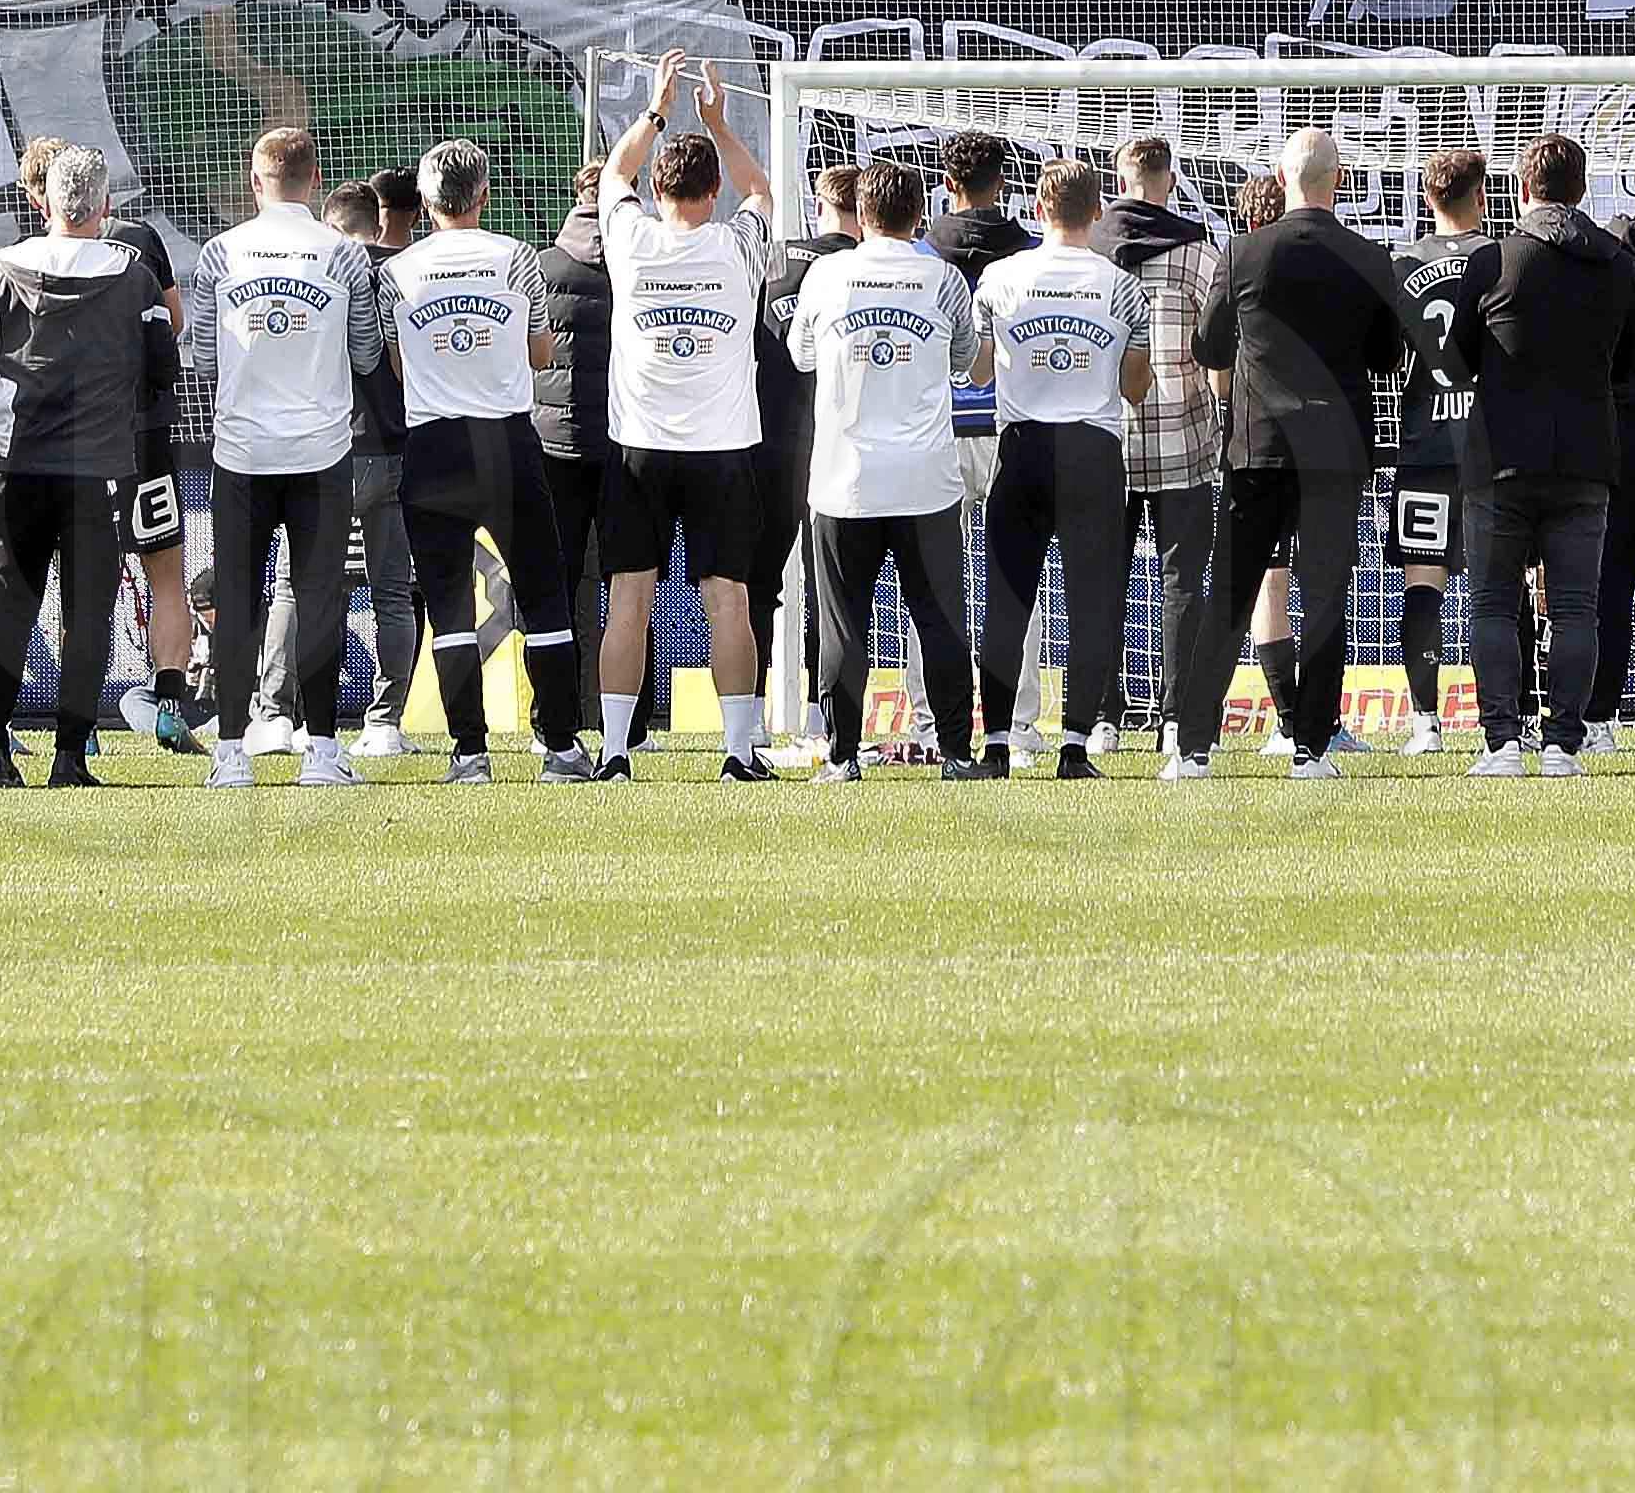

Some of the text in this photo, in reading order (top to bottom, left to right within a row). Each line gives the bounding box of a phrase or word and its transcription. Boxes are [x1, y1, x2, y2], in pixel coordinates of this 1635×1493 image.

[227, 277, 335, 311] PUNTIGAMER
[408, 295, 513, 331] PUNTIGAMER
[635, 306, 735, 335] PUNTIGAMER
[835, 306, 934, 340] PUNTIGAMER
[1010, 314, 1112, 350] PUNTIGAMER
